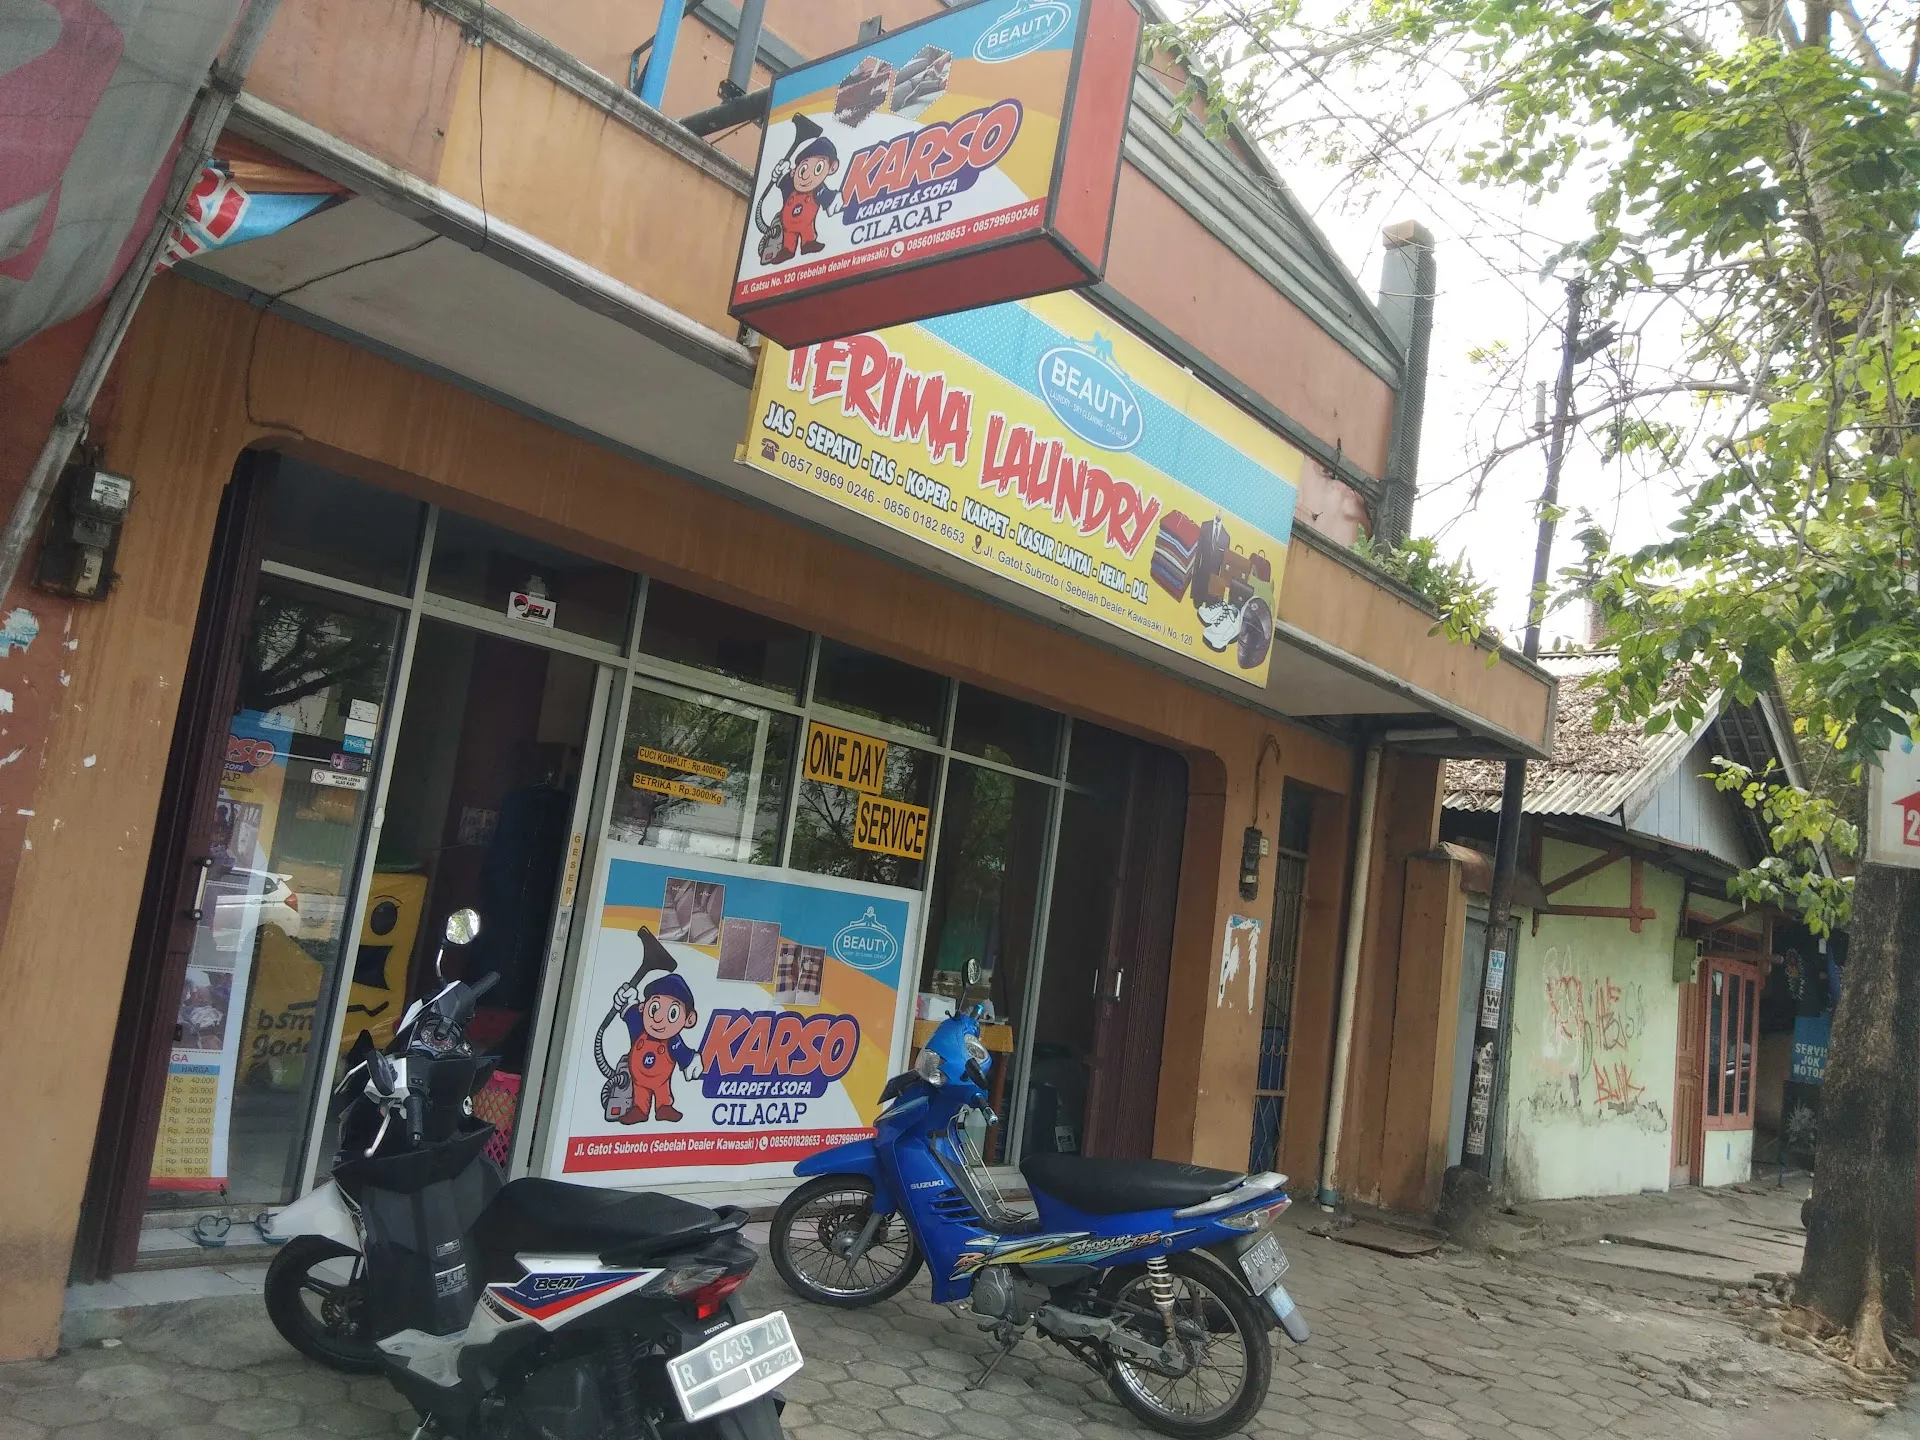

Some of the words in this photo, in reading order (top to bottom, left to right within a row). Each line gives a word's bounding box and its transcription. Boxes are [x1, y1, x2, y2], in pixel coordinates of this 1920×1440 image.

[987, 11, 1057, 48] BEAUTY
[842, 101, 1019, 206] KARSO
[856, 194, 908, 221] KARPET
[908, 192, 920, 203] &
[920, 178, 959, 200] SOFA
[850, 199, 953, 245] CILACAP
[750, 280, 771, 293] Gatsu
[770, 277, 783, 288] No.
[784, 272, 797, 284] 120
[797, 262, 827, 283] (sebelah
[828, 259, 852, 273] dealer
[851, 247, 890, 266] kawasaki)
[907, 225, 966, 252] 085601828653
[972, 204, 1040, 234] 085799690246
[1051, 356, 1134, 427] BEAUTY
[763, 400, 796, 438] JAS
[805, 421, 862, 469] SEPATU
[870, 450, 897, 485] TAS
[904, 468, 951, 512] KOPER
[962, 497, 1011, 539] KARPET
[1016, 521, 1056, 562] KASUR
[1055, 541, 1092, 578] LANTAI
[1098, 562, 1126, 594] HELM
[1131, 577, 1149, 605] DLL
[980, 413, 1162, 557] LAUNDRY
[781, 450, 813, 475] 0857
[814, 466, 845, 489] 9969
[846, 480, 875, 504] 0246
[883, 496, 911, 520] 0856
[912, 509, 938, 532] 0182
[940, 522, 966, 545] 8653
[983, 547, 995, 560] Jl.
[997, 550, 1023, 572] Gatot
[1024, 561, 1060, 588] Subroto
[1065, 580, 1099, 605] Sebelah
[1100, 597, 1127, 618] Dealer
[1127, 608, 1163, 633] Kawasaki
[1167, 626, 1179, 640] No.
[1180, 632, 1193, 646] 120
[224, 763, 244, 771] SOFA
[639, 748, 656, 760] CUCI
[657, 753, 687, 768] KOMPLIT
[809, 729, 844, 780] ONE
[848, 740, 887, 787] DAY
[634, 774, 671, 790] SETRIKA
[678, 785, 722, 805] Rp.3000/Kg
[858, 802, 927, 854] SERVICE
[565, 835, 581, 895] GESER
[842, 935, 889, 953] BEAUTY
[643, 1055, 655, 1065] KS
[702, 1014, 858, 1077] KARSO
[1801, 1055, 1821, 1068] JOK
[181, 1065, 210, 1074] HARGA
[717, 1081, 771, 1096] KARPET
[771, 1081, 779, 1096] &
[781, 1081, 812, 1096] SOFA
[711, 1102, 807, 1126] CILACAP
[574, 1145, 585, 1157] Jl.
[587, 1142, 612, 1156] Gatot
[614, 1139, 648, 1155] Subroto
[650, 1138, 687, 1154] (Sebelah
[687, 1137, 715, 1151] Dealer
[716, 1136, 754, 1151] Kawasaki
[769, 1134, 821, 1148] 085601828653
[910, 1180, 944, 1190] SUZUKI
[1241, 1260, 1253, 1277] R
[1250, 1245, 1269, 1268] 6083
[1267, 1236, 1279, 1254] KB
[703, 1321, 730, 1336] HONDA
[680, 1363, 698, 1388] R
[709, 1334, 754, 1372] 6439
[762, 1321, 784, 1346] ZN
